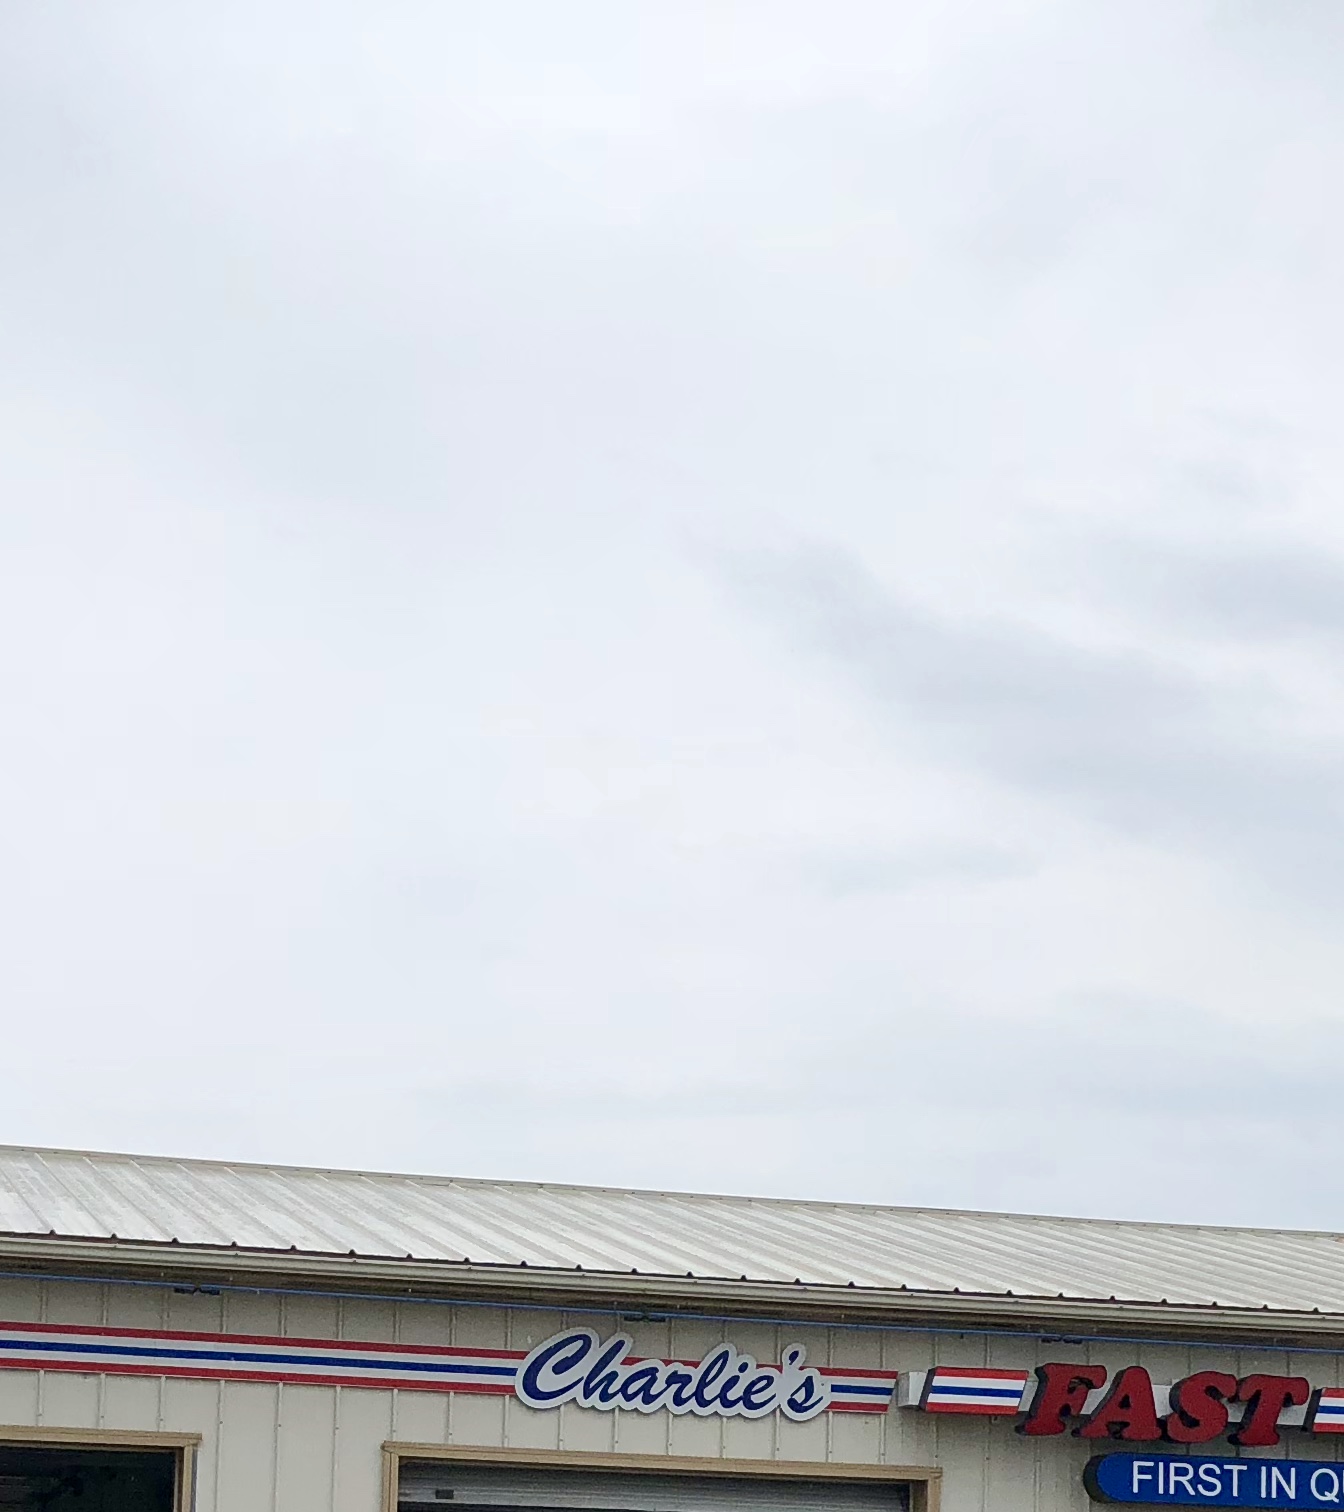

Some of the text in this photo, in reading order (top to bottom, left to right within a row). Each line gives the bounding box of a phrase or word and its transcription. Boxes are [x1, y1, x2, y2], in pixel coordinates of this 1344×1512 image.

[522, 1333, 824, 1414] Charlie's
[1015, 1362, 1310, 1447] FAST
[1131, 1459, 1248, 1498] FIRST
[1259, 1465, 1297, 1501] IN
